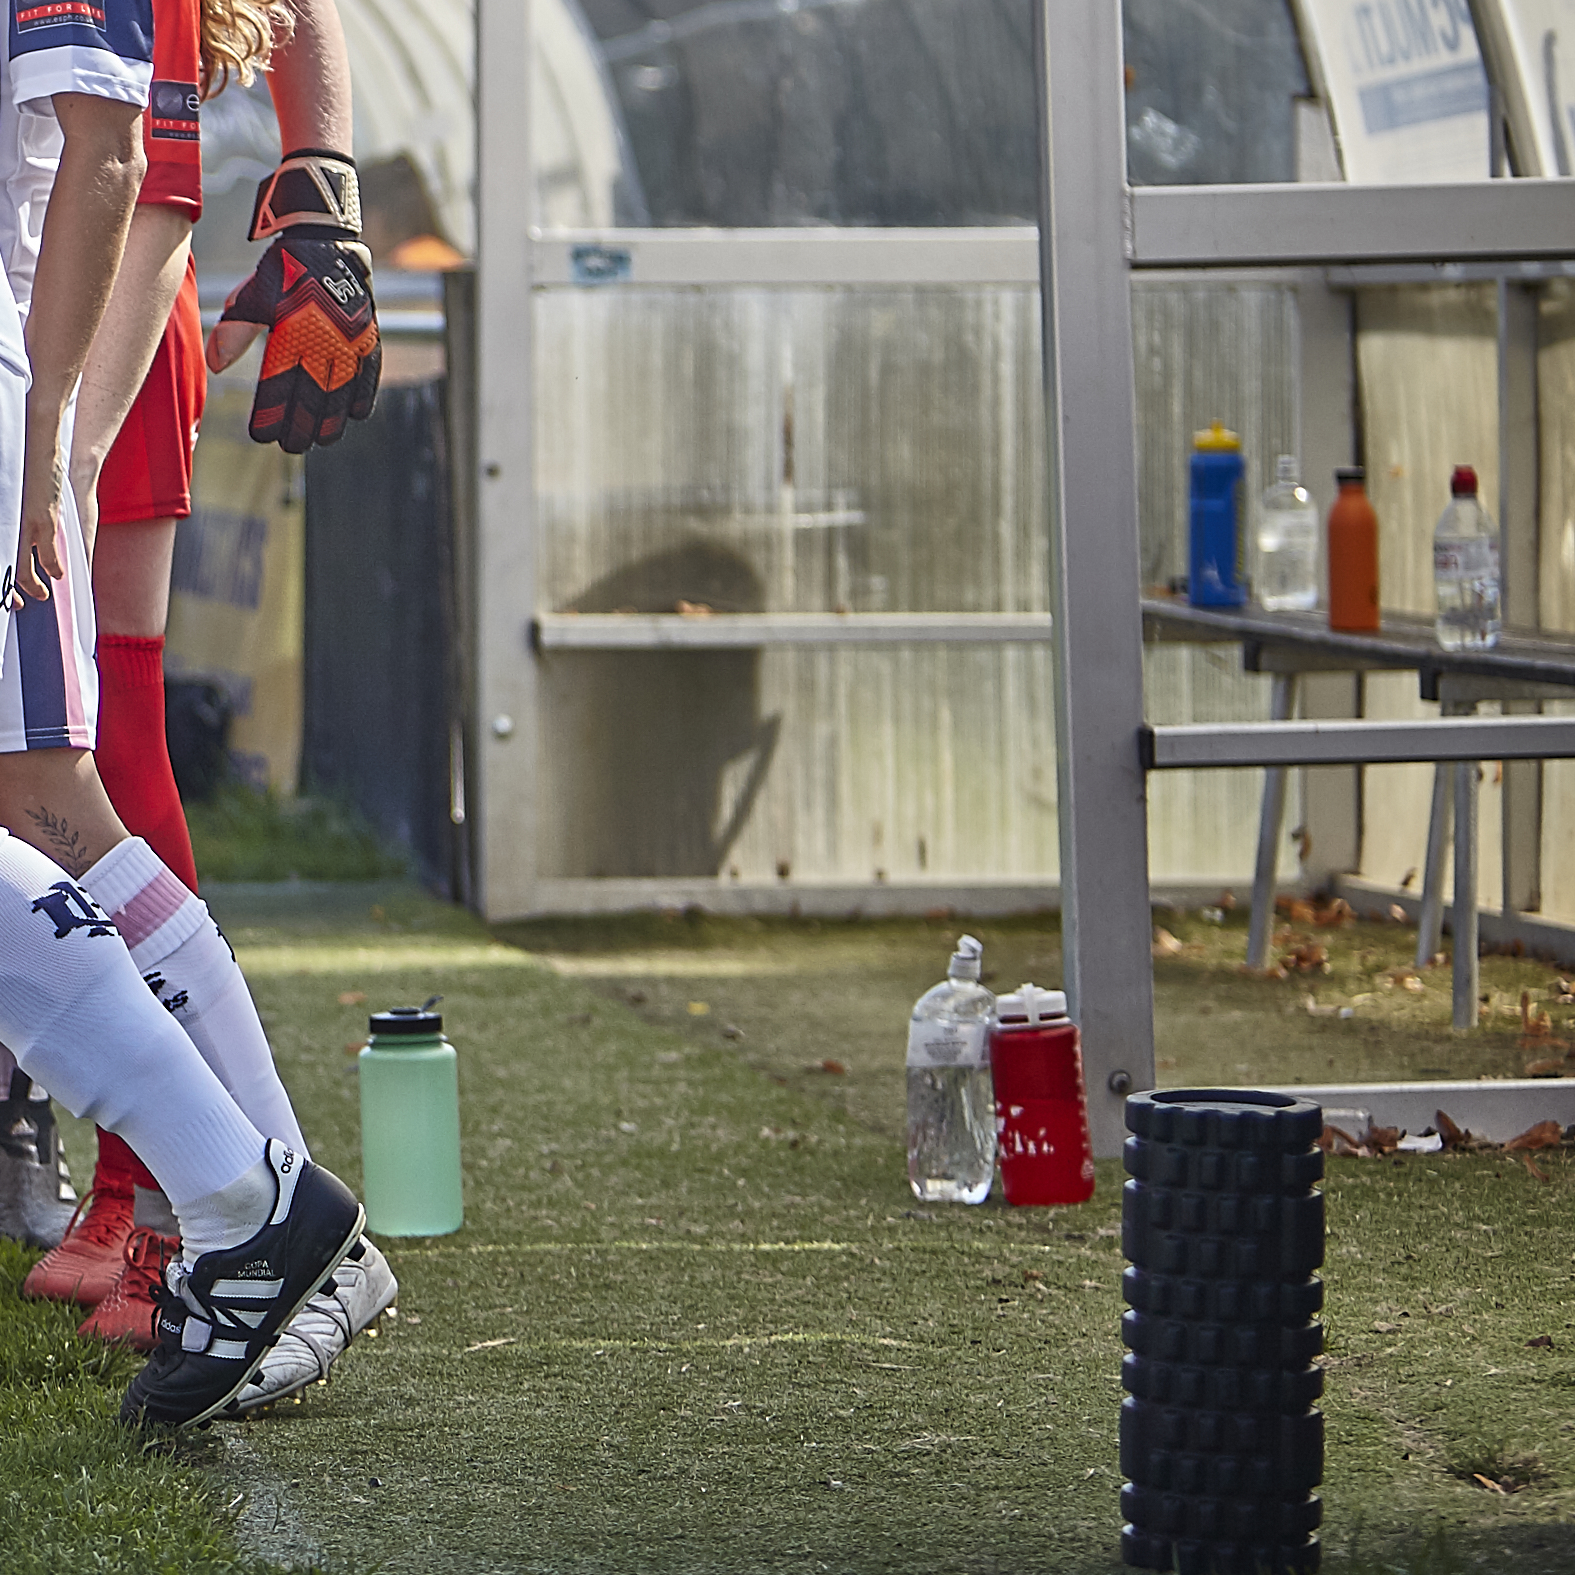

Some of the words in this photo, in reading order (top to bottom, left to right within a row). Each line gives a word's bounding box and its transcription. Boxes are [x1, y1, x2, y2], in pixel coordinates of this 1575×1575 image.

[20, 8, 39, 19] FIT
[47, 4, 72, 13] FOR
[226, 1268, 276, 1279] MUNDIAL
